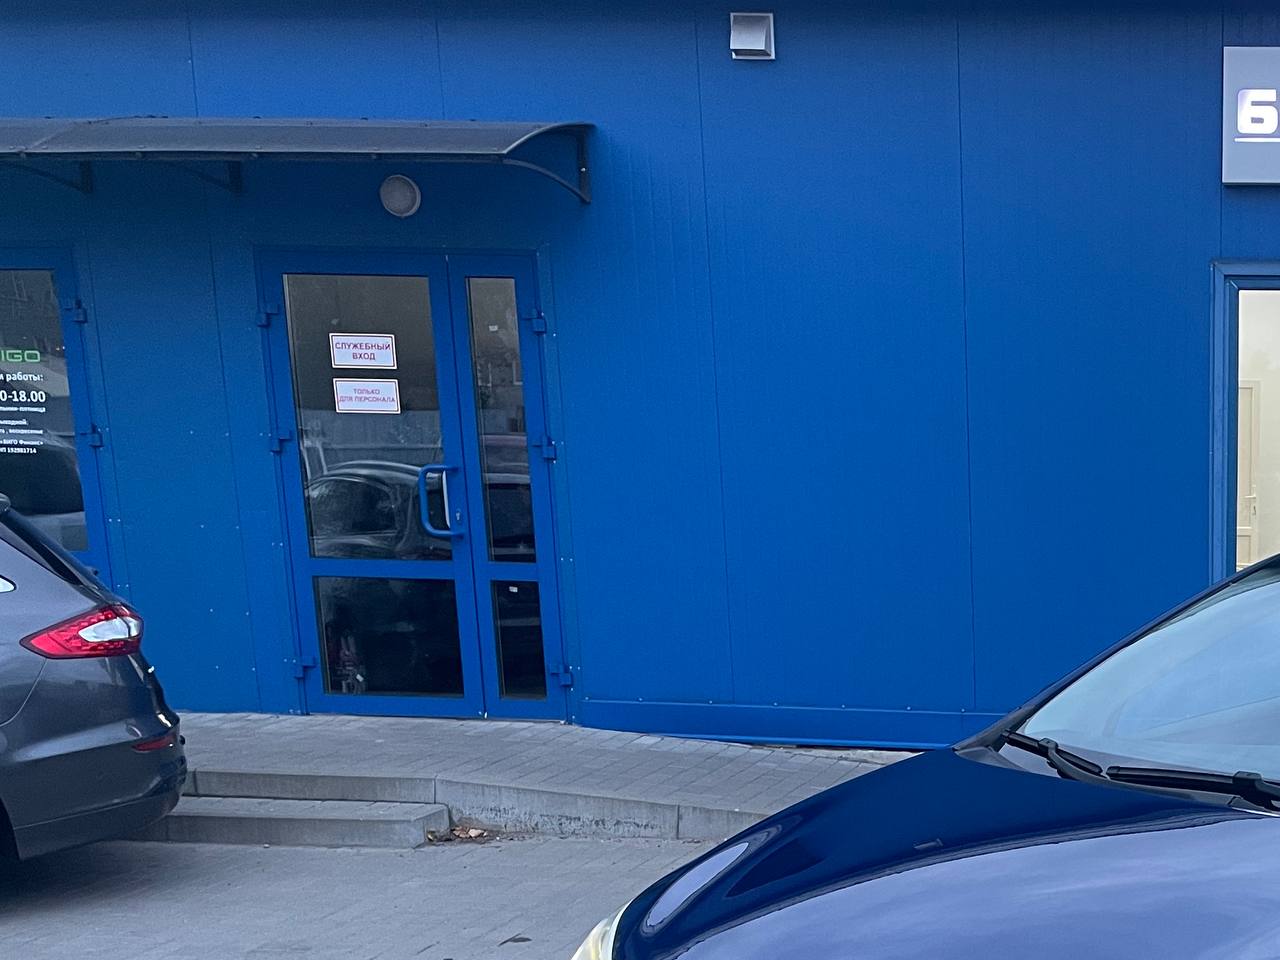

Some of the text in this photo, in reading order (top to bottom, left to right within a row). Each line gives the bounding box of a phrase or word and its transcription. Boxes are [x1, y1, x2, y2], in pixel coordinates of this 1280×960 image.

[335, 342, 391, 350] СЛУЖЕБНЫЙ
[352, 352, 376, 361] ВХОД
[6, 371, 44, 382] работы:
